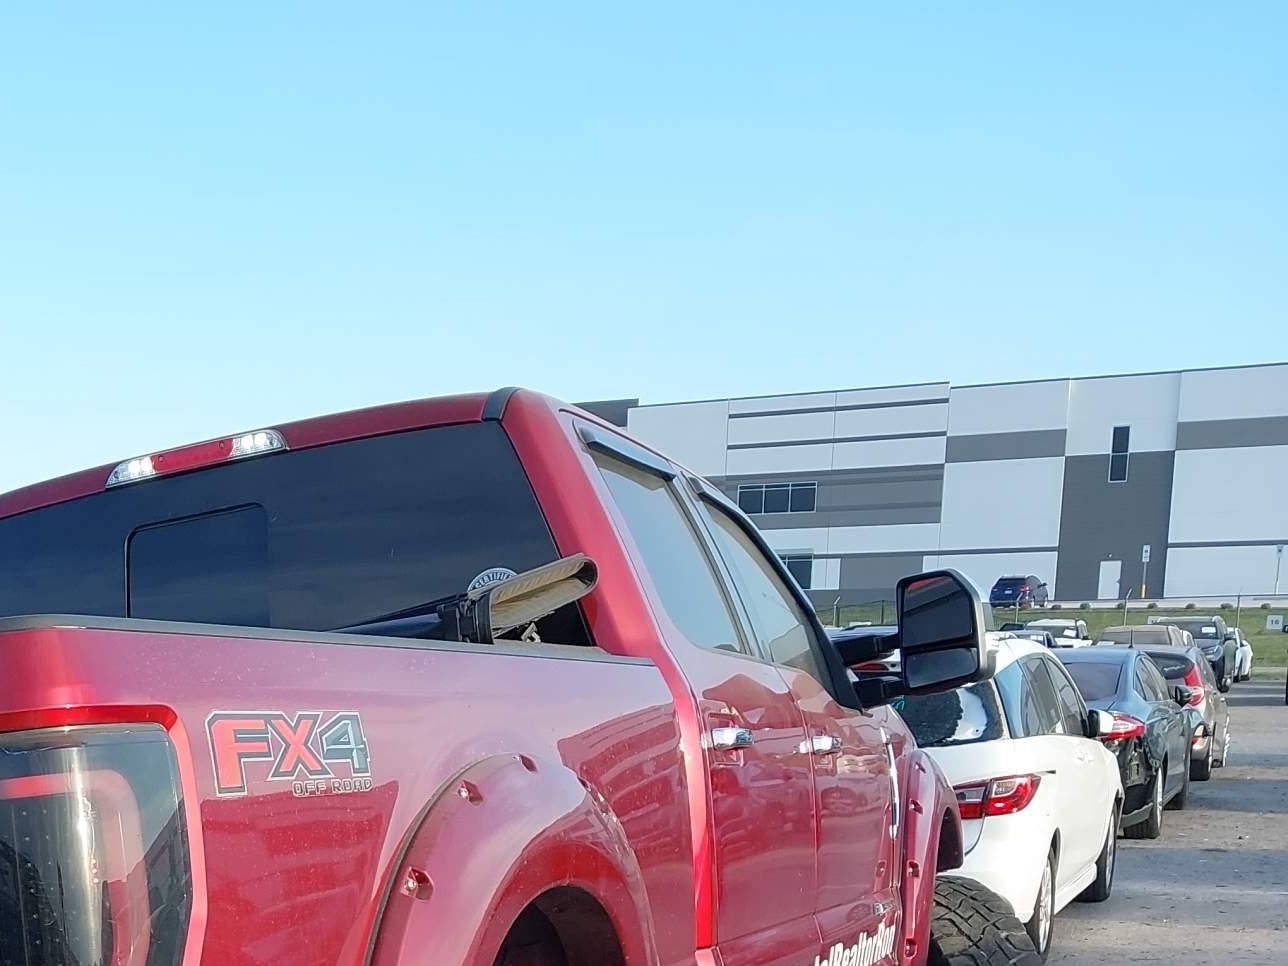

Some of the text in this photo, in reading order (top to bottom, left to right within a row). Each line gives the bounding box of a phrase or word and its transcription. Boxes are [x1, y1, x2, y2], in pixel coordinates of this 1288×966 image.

[205, 710, 372, 795] FX4
[292, 776, 373, 797] OFF ROAD
